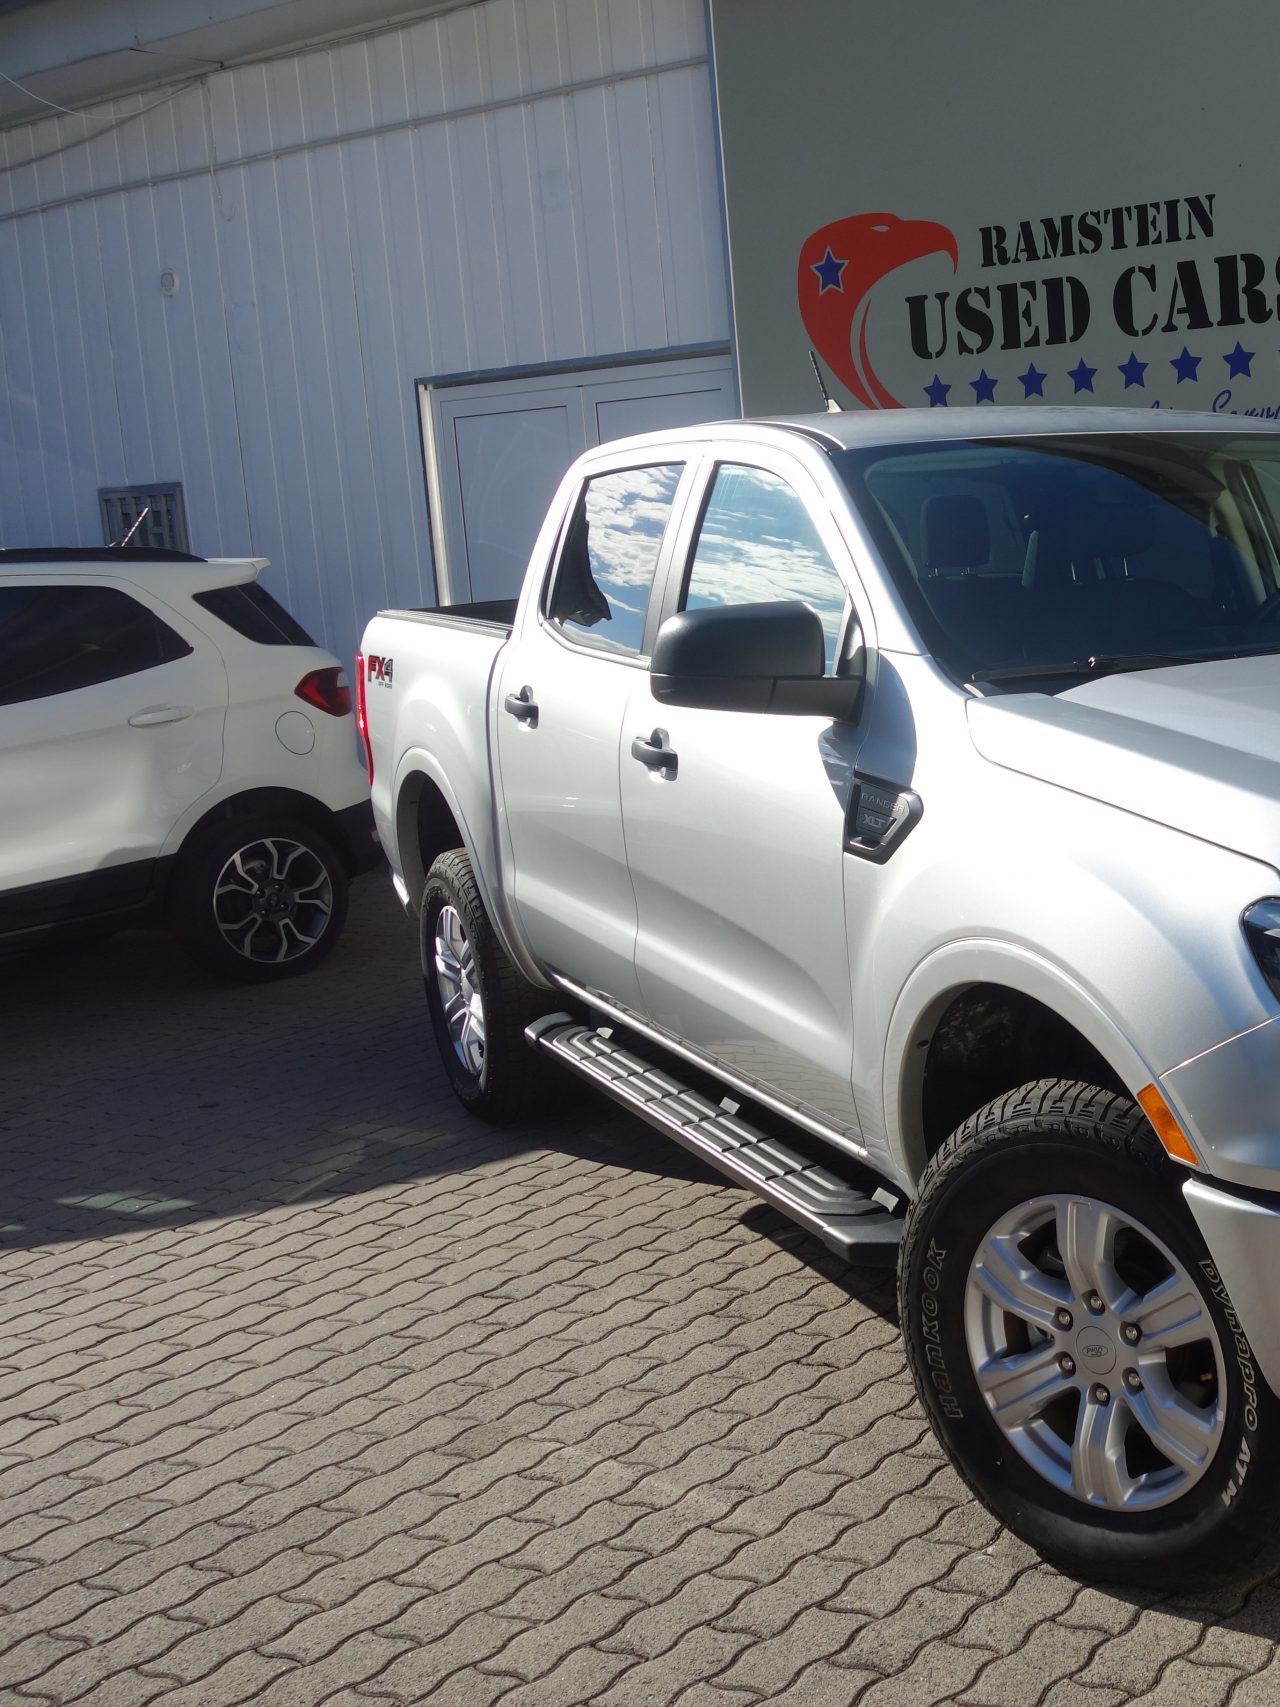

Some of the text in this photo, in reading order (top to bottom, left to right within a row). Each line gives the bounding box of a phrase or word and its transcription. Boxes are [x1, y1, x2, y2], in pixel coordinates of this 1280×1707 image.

[979, 193, 1216, 268] RAMSTEIN
[905, 275, 1091, 360] USED
[367, 654, 393, 683] FX4
[861, 792, 905, 815] RANGER
[863, 813, 888, 829] XLT
